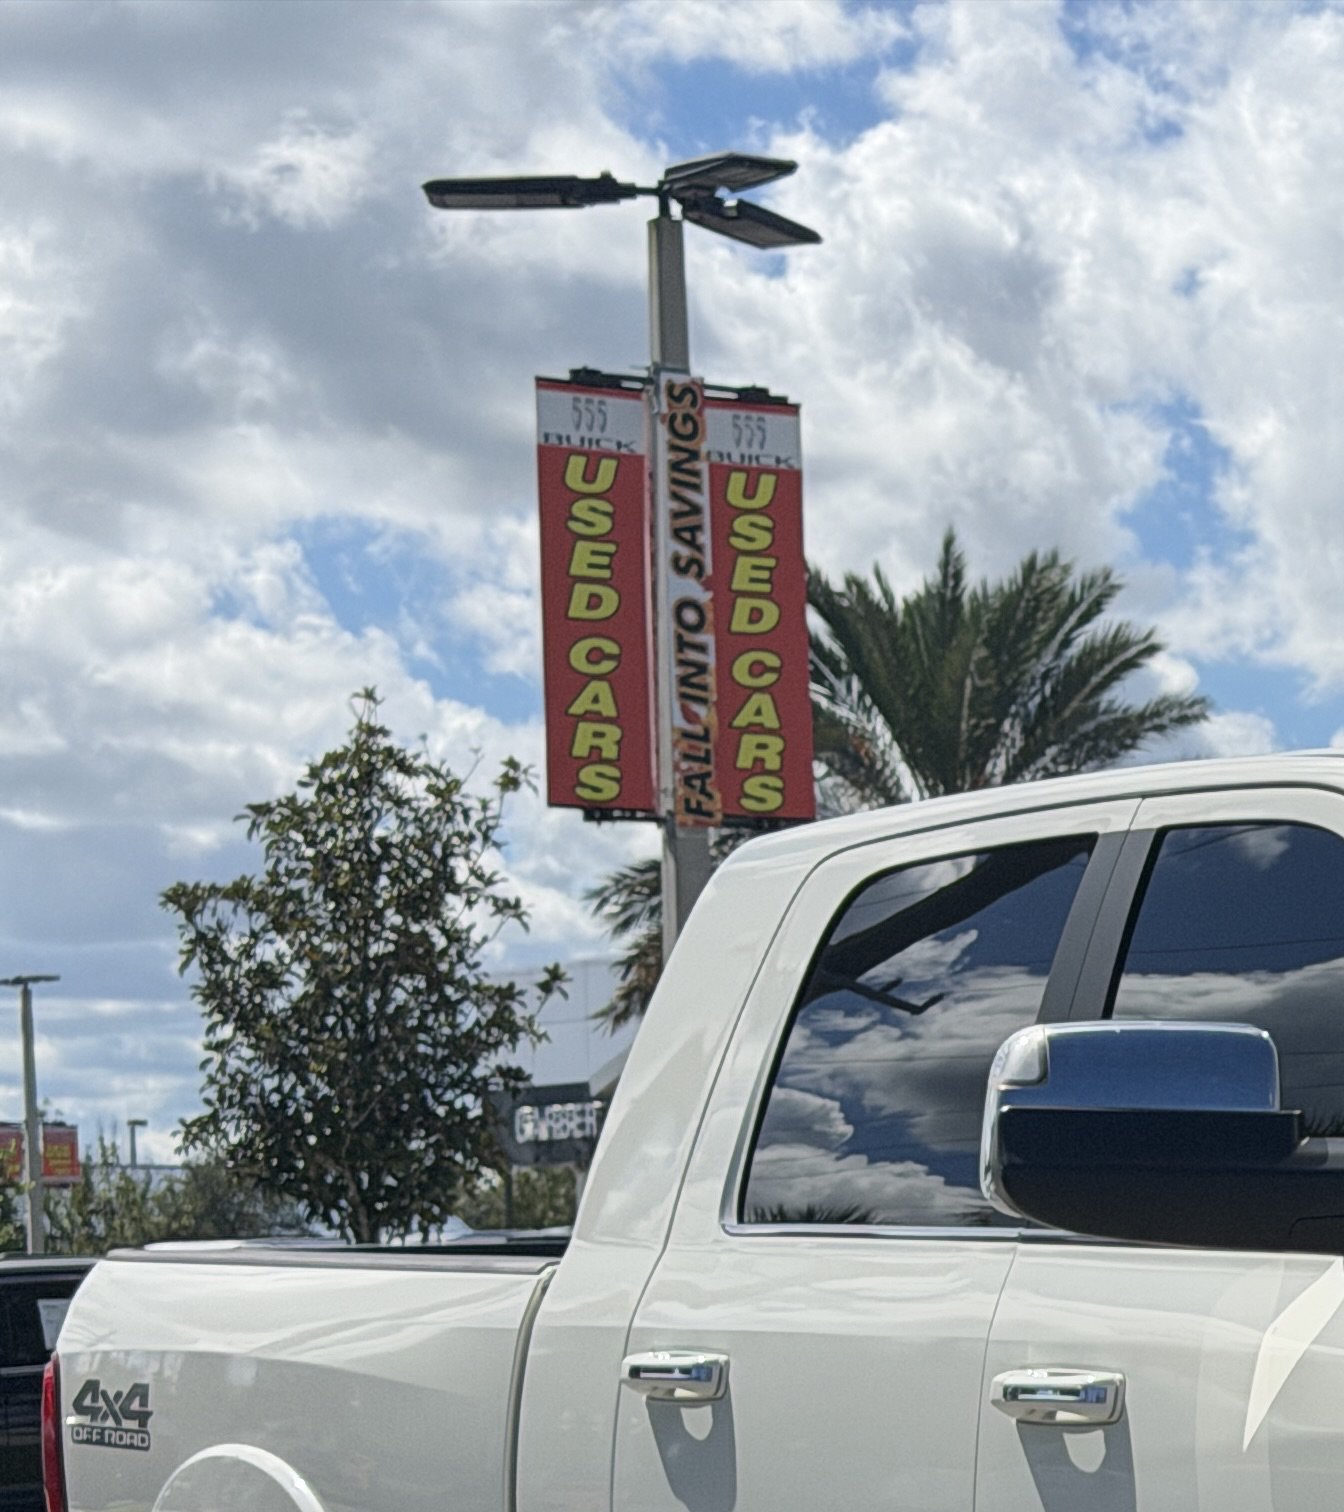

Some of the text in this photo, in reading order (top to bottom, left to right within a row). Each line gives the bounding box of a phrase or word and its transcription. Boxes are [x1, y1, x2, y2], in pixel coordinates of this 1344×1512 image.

[563, 453, 624, 802] USED CARS
[667, 383, 715, 819] FALL INTO SAVINGS
[726, 470, 786, 814] USED CARS
[73, 1426, 150, 1448] OFF ROAD
